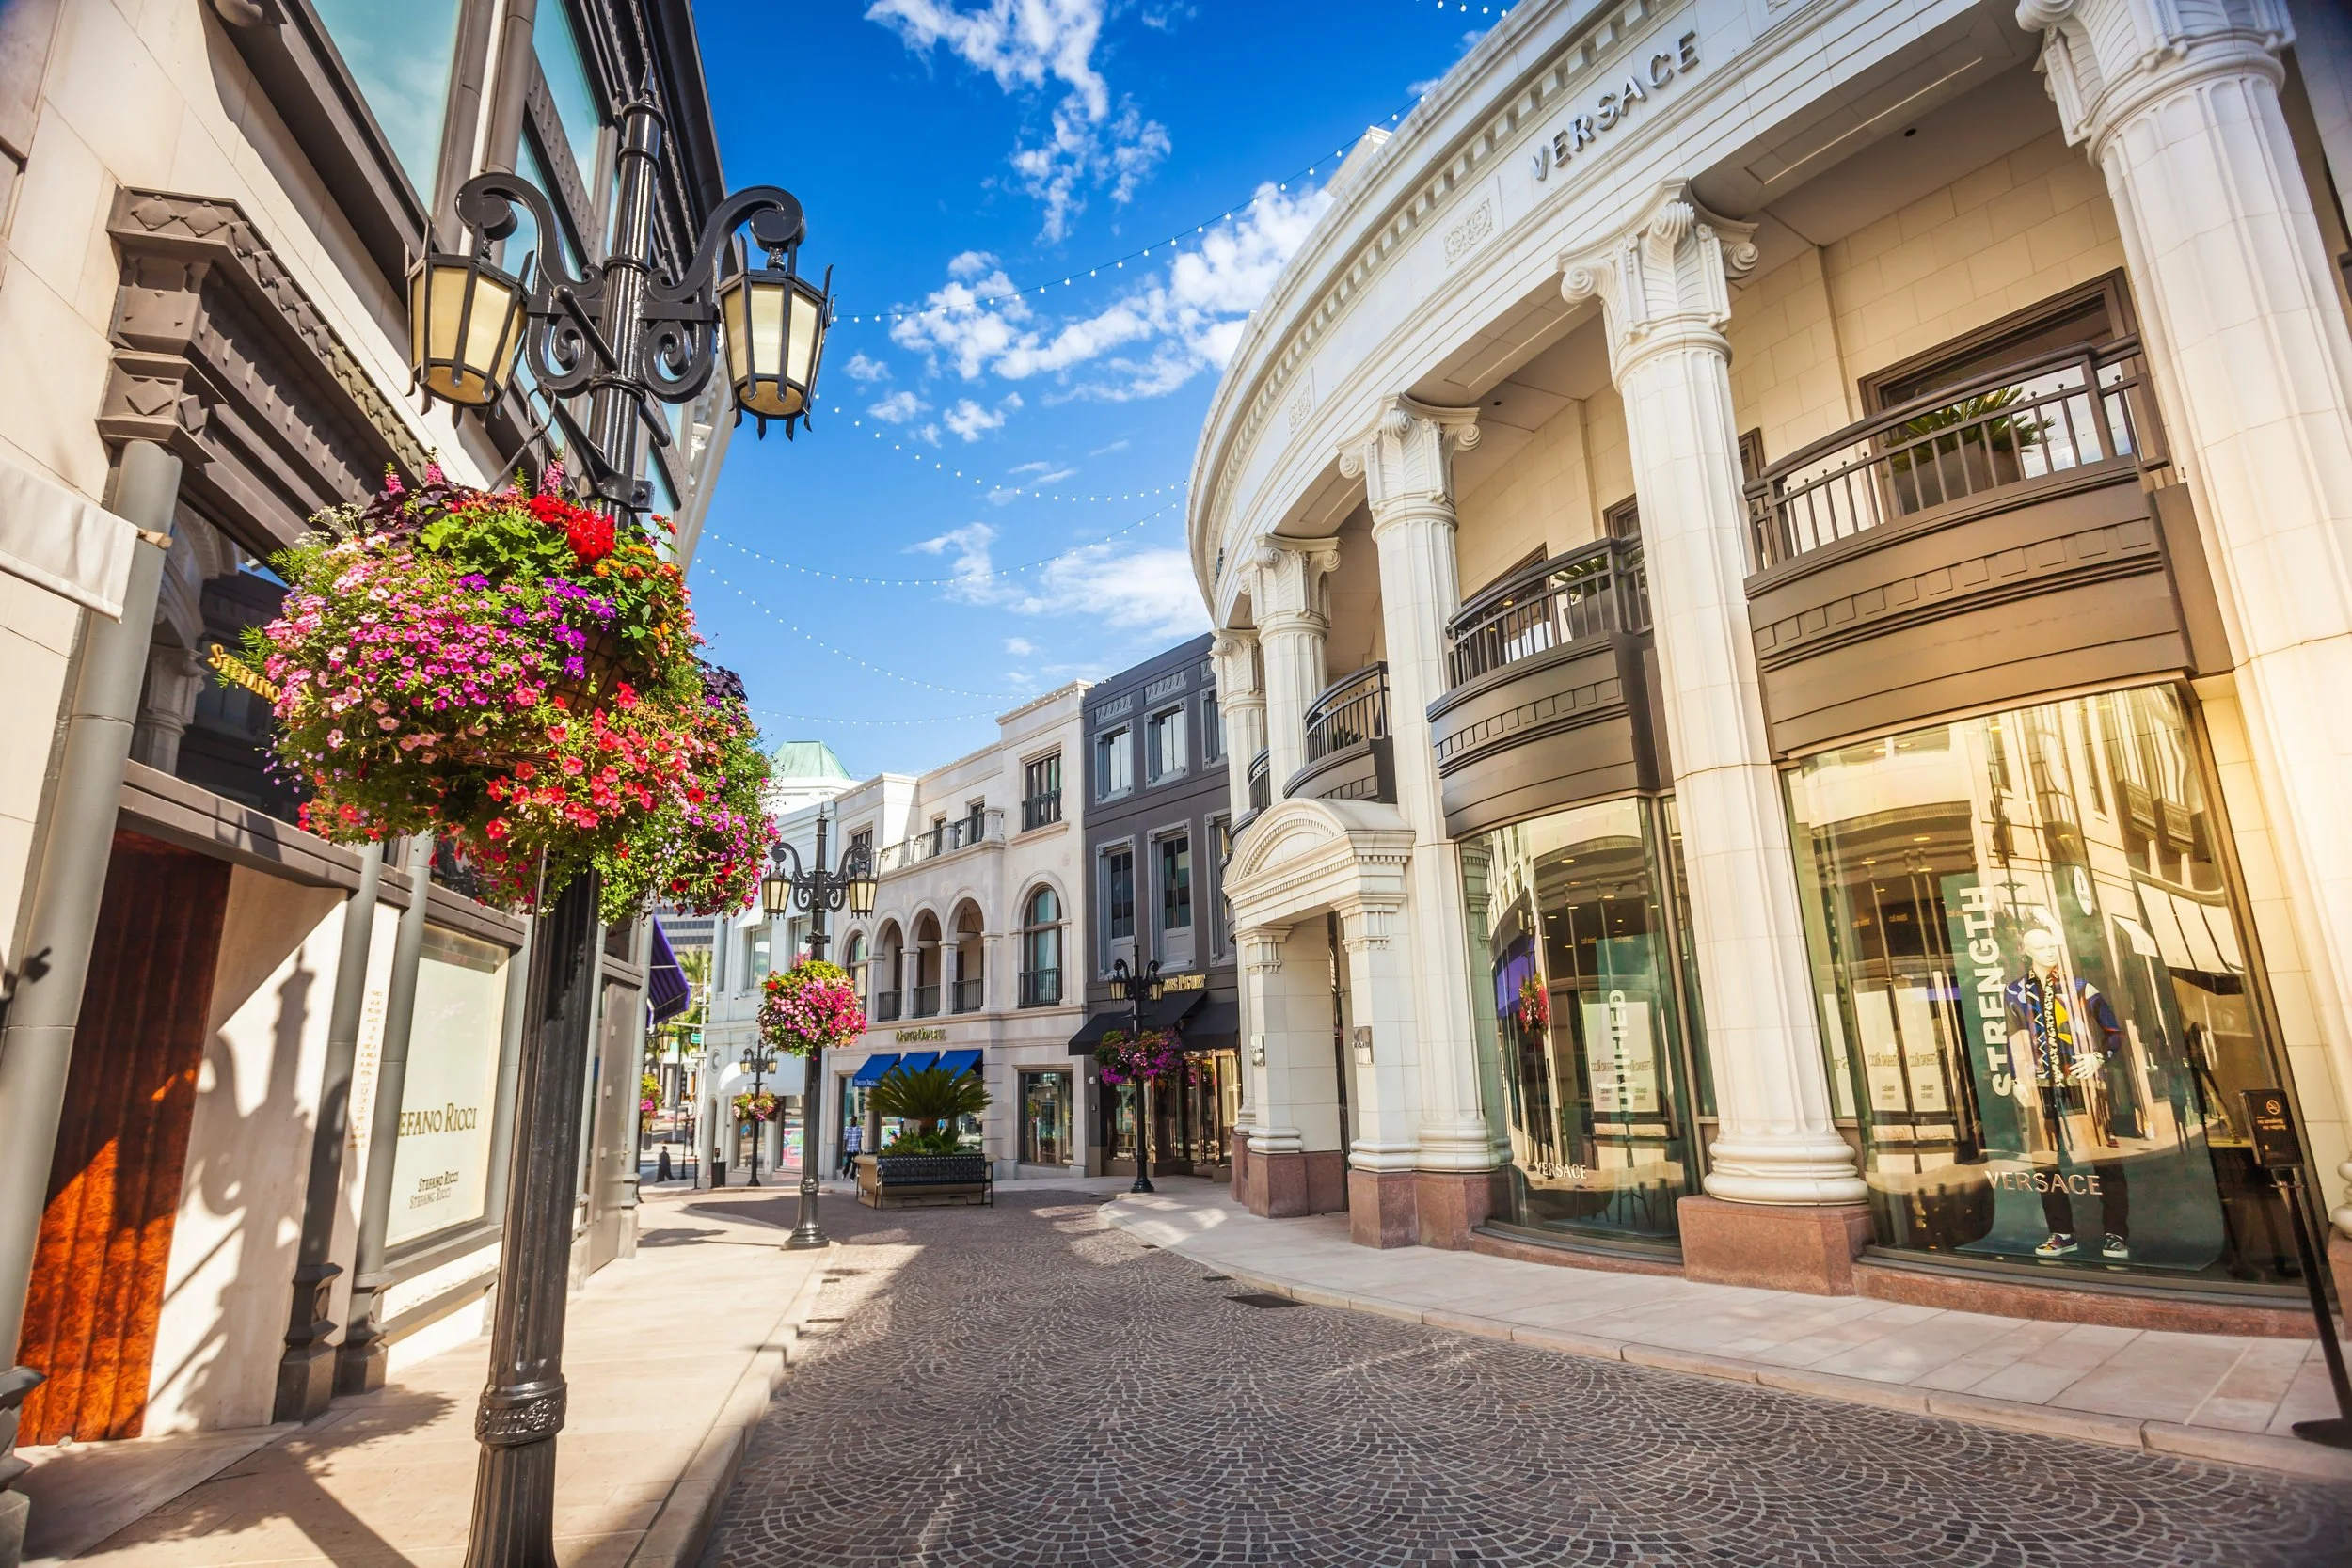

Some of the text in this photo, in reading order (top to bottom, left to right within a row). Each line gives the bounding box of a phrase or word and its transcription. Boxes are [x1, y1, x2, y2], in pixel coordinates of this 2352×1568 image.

[1530, 29, 1700, 182] VERSACE
[1960, 886, 2013, 1097] STRENGTH
[398, 1102, 478, 1137] EFANO RICCI
[418, 1171, 459, 1192] STEFANO RICCI
[1534, 1161, 1587, 1180] VERSACE
[1984, 1170, 2103, 1196] VERSACE
